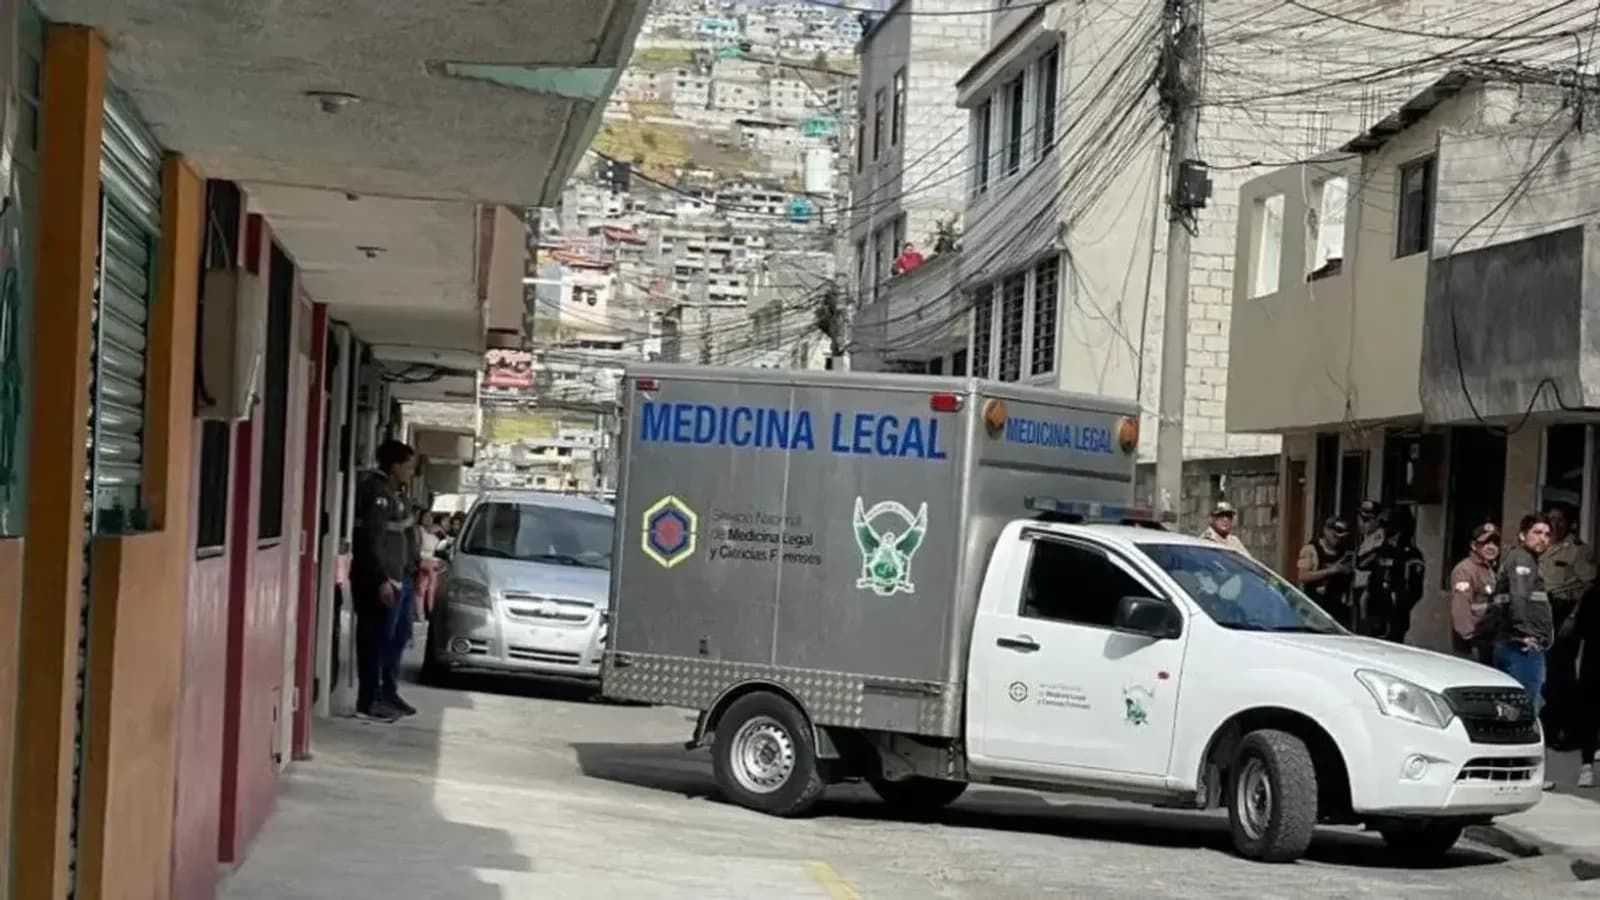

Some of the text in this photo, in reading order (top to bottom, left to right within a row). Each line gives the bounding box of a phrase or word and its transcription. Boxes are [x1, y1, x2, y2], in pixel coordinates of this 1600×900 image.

[640, 402, 947, 460] MEDICINA LEGAL
[1006, 416, 1113, 454] MEDICINA LEGAL
[728, 528, 780, 544] Medicina
[782, 532, 814, 548] Legal
[709, 545, 822, 565] y Ciencias Frenses
